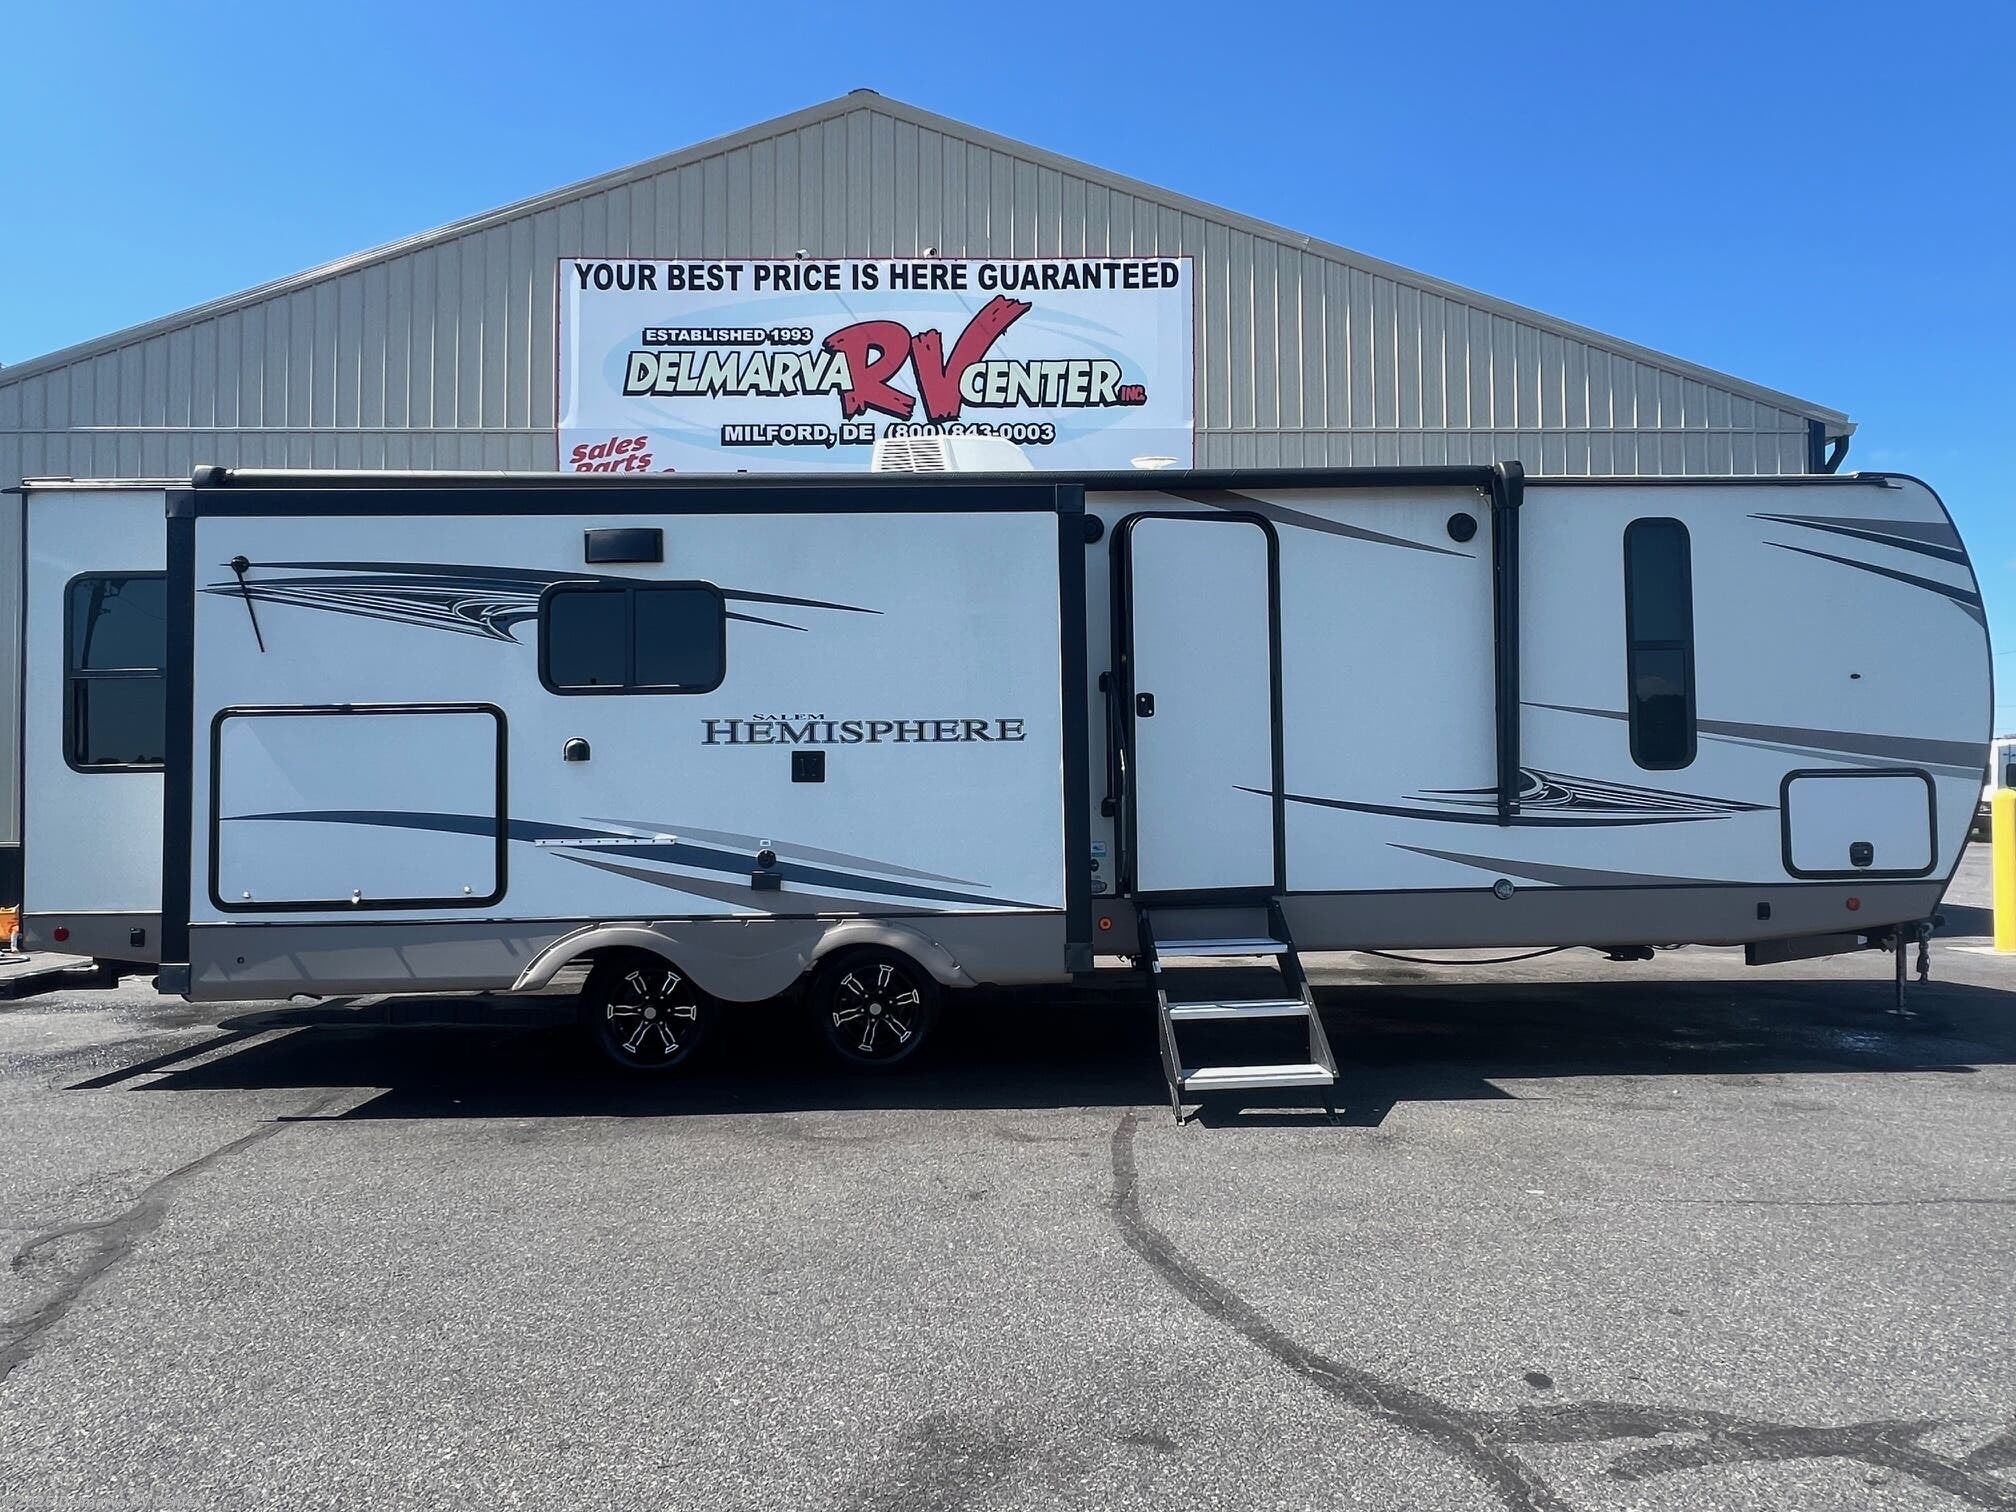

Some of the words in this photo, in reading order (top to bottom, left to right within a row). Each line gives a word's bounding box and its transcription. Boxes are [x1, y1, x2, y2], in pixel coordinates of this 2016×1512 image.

[575, 263, 657, 291] YOUR
[667, 263, 744, 291] BEST
[754, 263, 841, 291] PRICE
[852, 263, 879, 290] IS
[889, 263, 968, 290] HERE
[978, 262, 1179, 290] GUARANTEED
[643, 328, 767, 344] ESTABLISHED
[770, 328, 813, 344] 1993
[623, 350, 854, 399] DELMARVA
[822, 295, 1032, 422] RV
[959, 359, 1122, 407] CENTER
[721, 423, 837, 448] MILFORD,
[839, 424, 875, 444] DE
[885, 423, 945, 438] (800)
[949, 423, 1056, 444] 843-0003
[569, 435, 648, 464] Sales
[752, 713, 825, 721] SALEM
[701, 718, 1027, 745] HEMISPHERE
